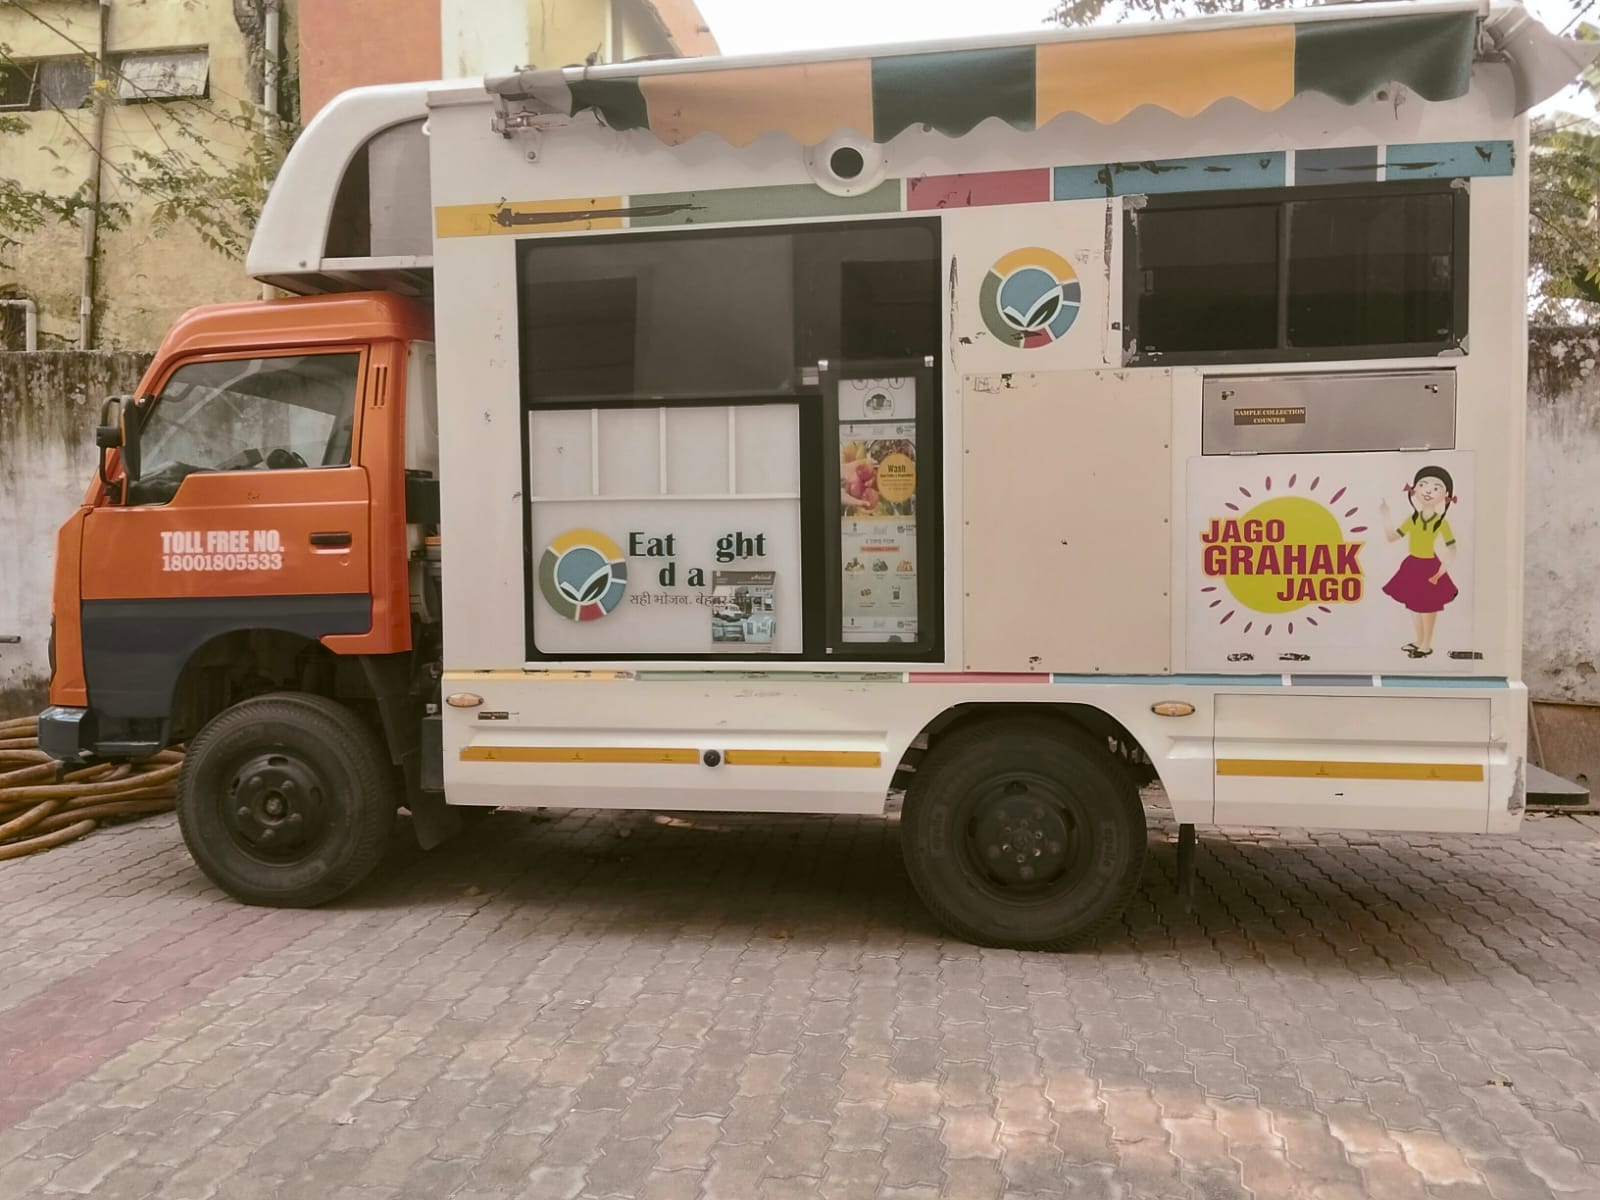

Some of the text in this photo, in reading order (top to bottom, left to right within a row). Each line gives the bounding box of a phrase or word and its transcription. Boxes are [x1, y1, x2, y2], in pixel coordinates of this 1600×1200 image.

[1235, 408, 1305, 417] SAMPLE COLLECTION
[887, 464, 906, 473] Wash
[160, 530, 285, 554] TOLL FREE NO.
[1201, 519, 1285, 543] JAGO
[629, 532, 676, 556] Eat
[161, 554, 283, 572] 18001805533
[1203, 543, 1362, 576] GRAHAK
[630, 590, 651, 606] सही
[1276, 577, 1362, 602] JAGO
